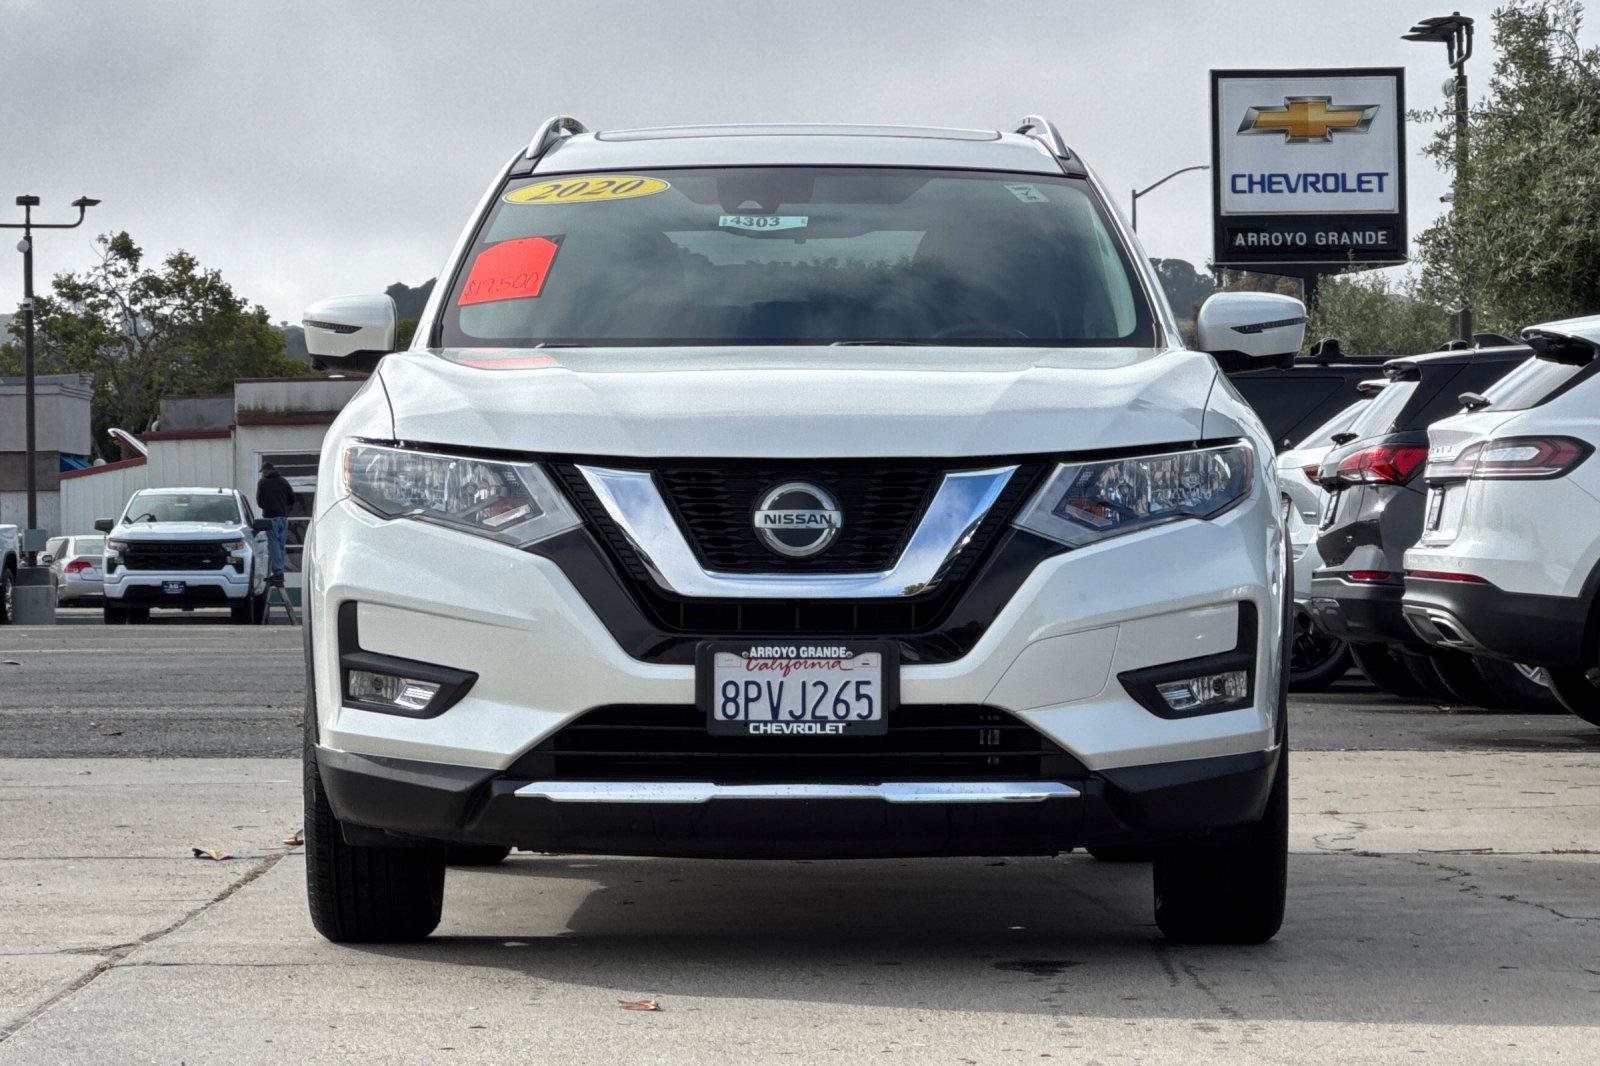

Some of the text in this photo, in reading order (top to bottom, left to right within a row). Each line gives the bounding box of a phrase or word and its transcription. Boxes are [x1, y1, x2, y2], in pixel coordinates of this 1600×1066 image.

[527, 179, 645, 201] 2020
[1231, 172, 1389, 194] CHEVROLET
[730, 216, 780, 227] 4303
[1235, 230, 1388, 246] ARROYO GRANDE
[764, 514, 832, 524] NISSAN
[749, 646, 846, 658] ARROYO GRANDE
[745, 658, 853, 678] California
[721, 680, 874, 720] 8PVJ265
[749, 722, 846, 734] CHEVROLET
